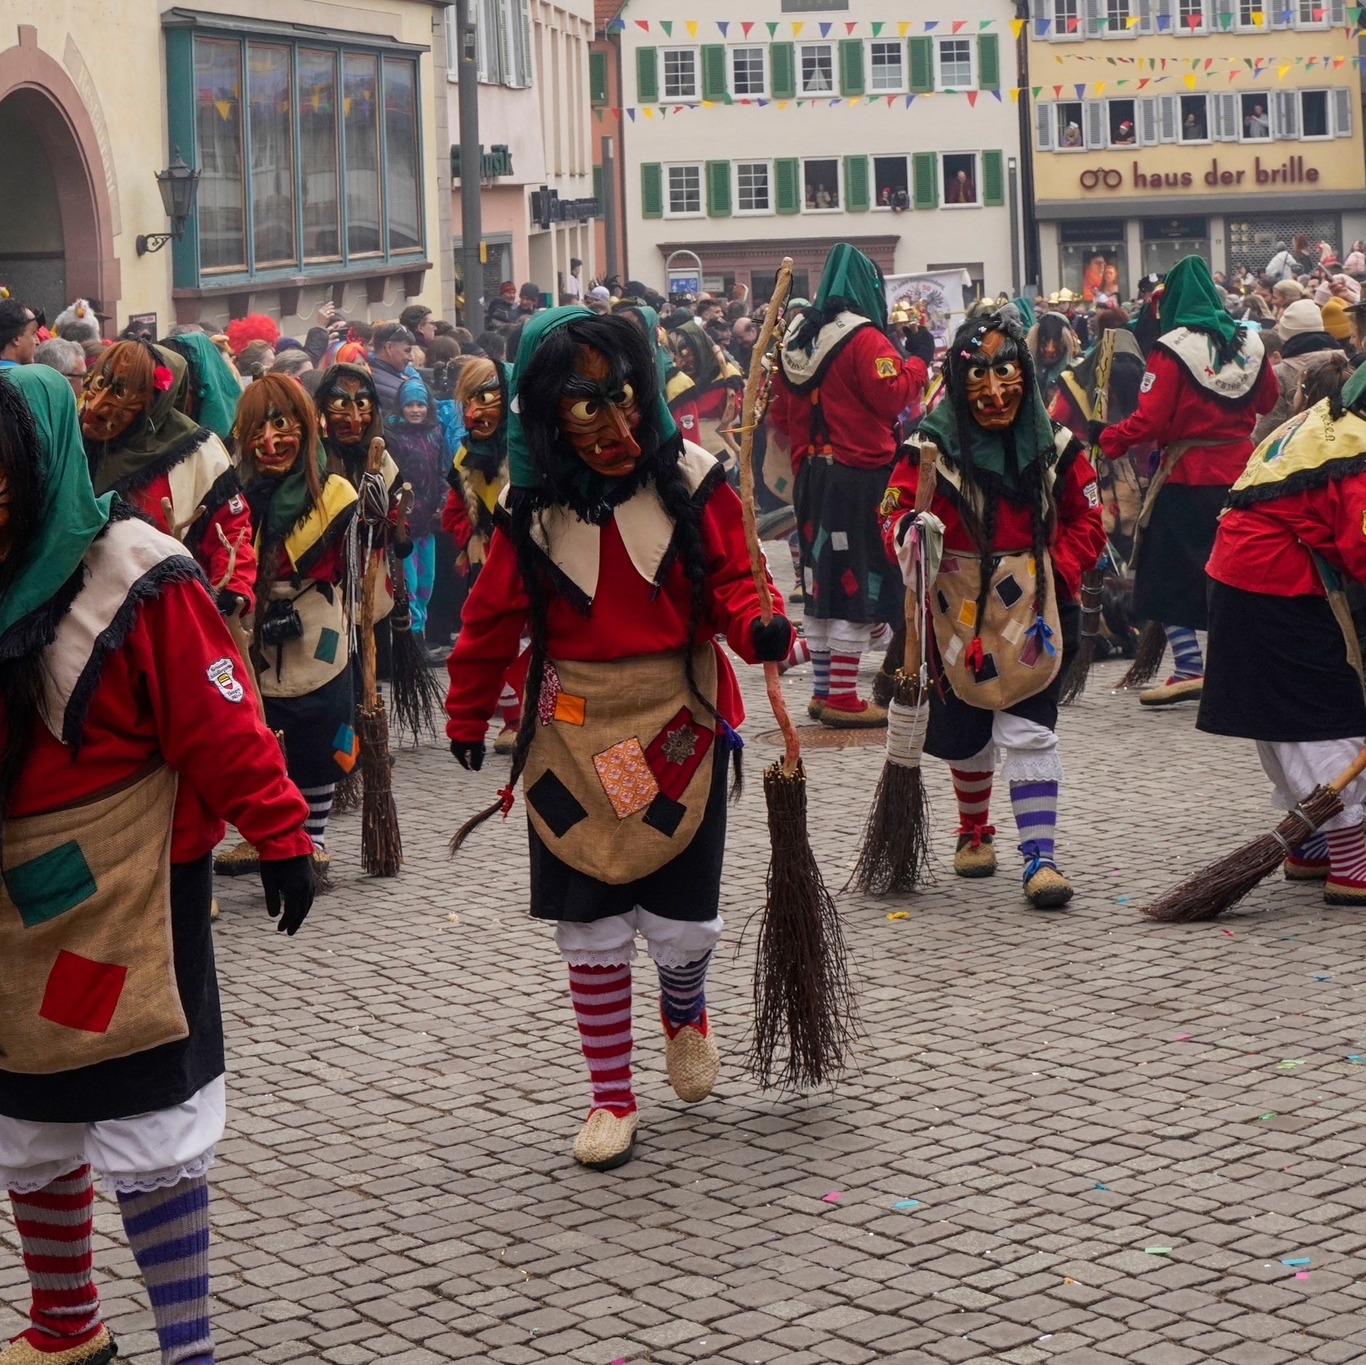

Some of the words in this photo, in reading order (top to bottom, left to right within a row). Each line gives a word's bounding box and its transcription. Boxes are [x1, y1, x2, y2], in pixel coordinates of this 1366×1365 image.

[478, 144, 514, 177] usik
[1133, 161, 1193, 188] haus
[1204, 158, 1245, 185] der
[1255, 155, 1320, 183] brille
